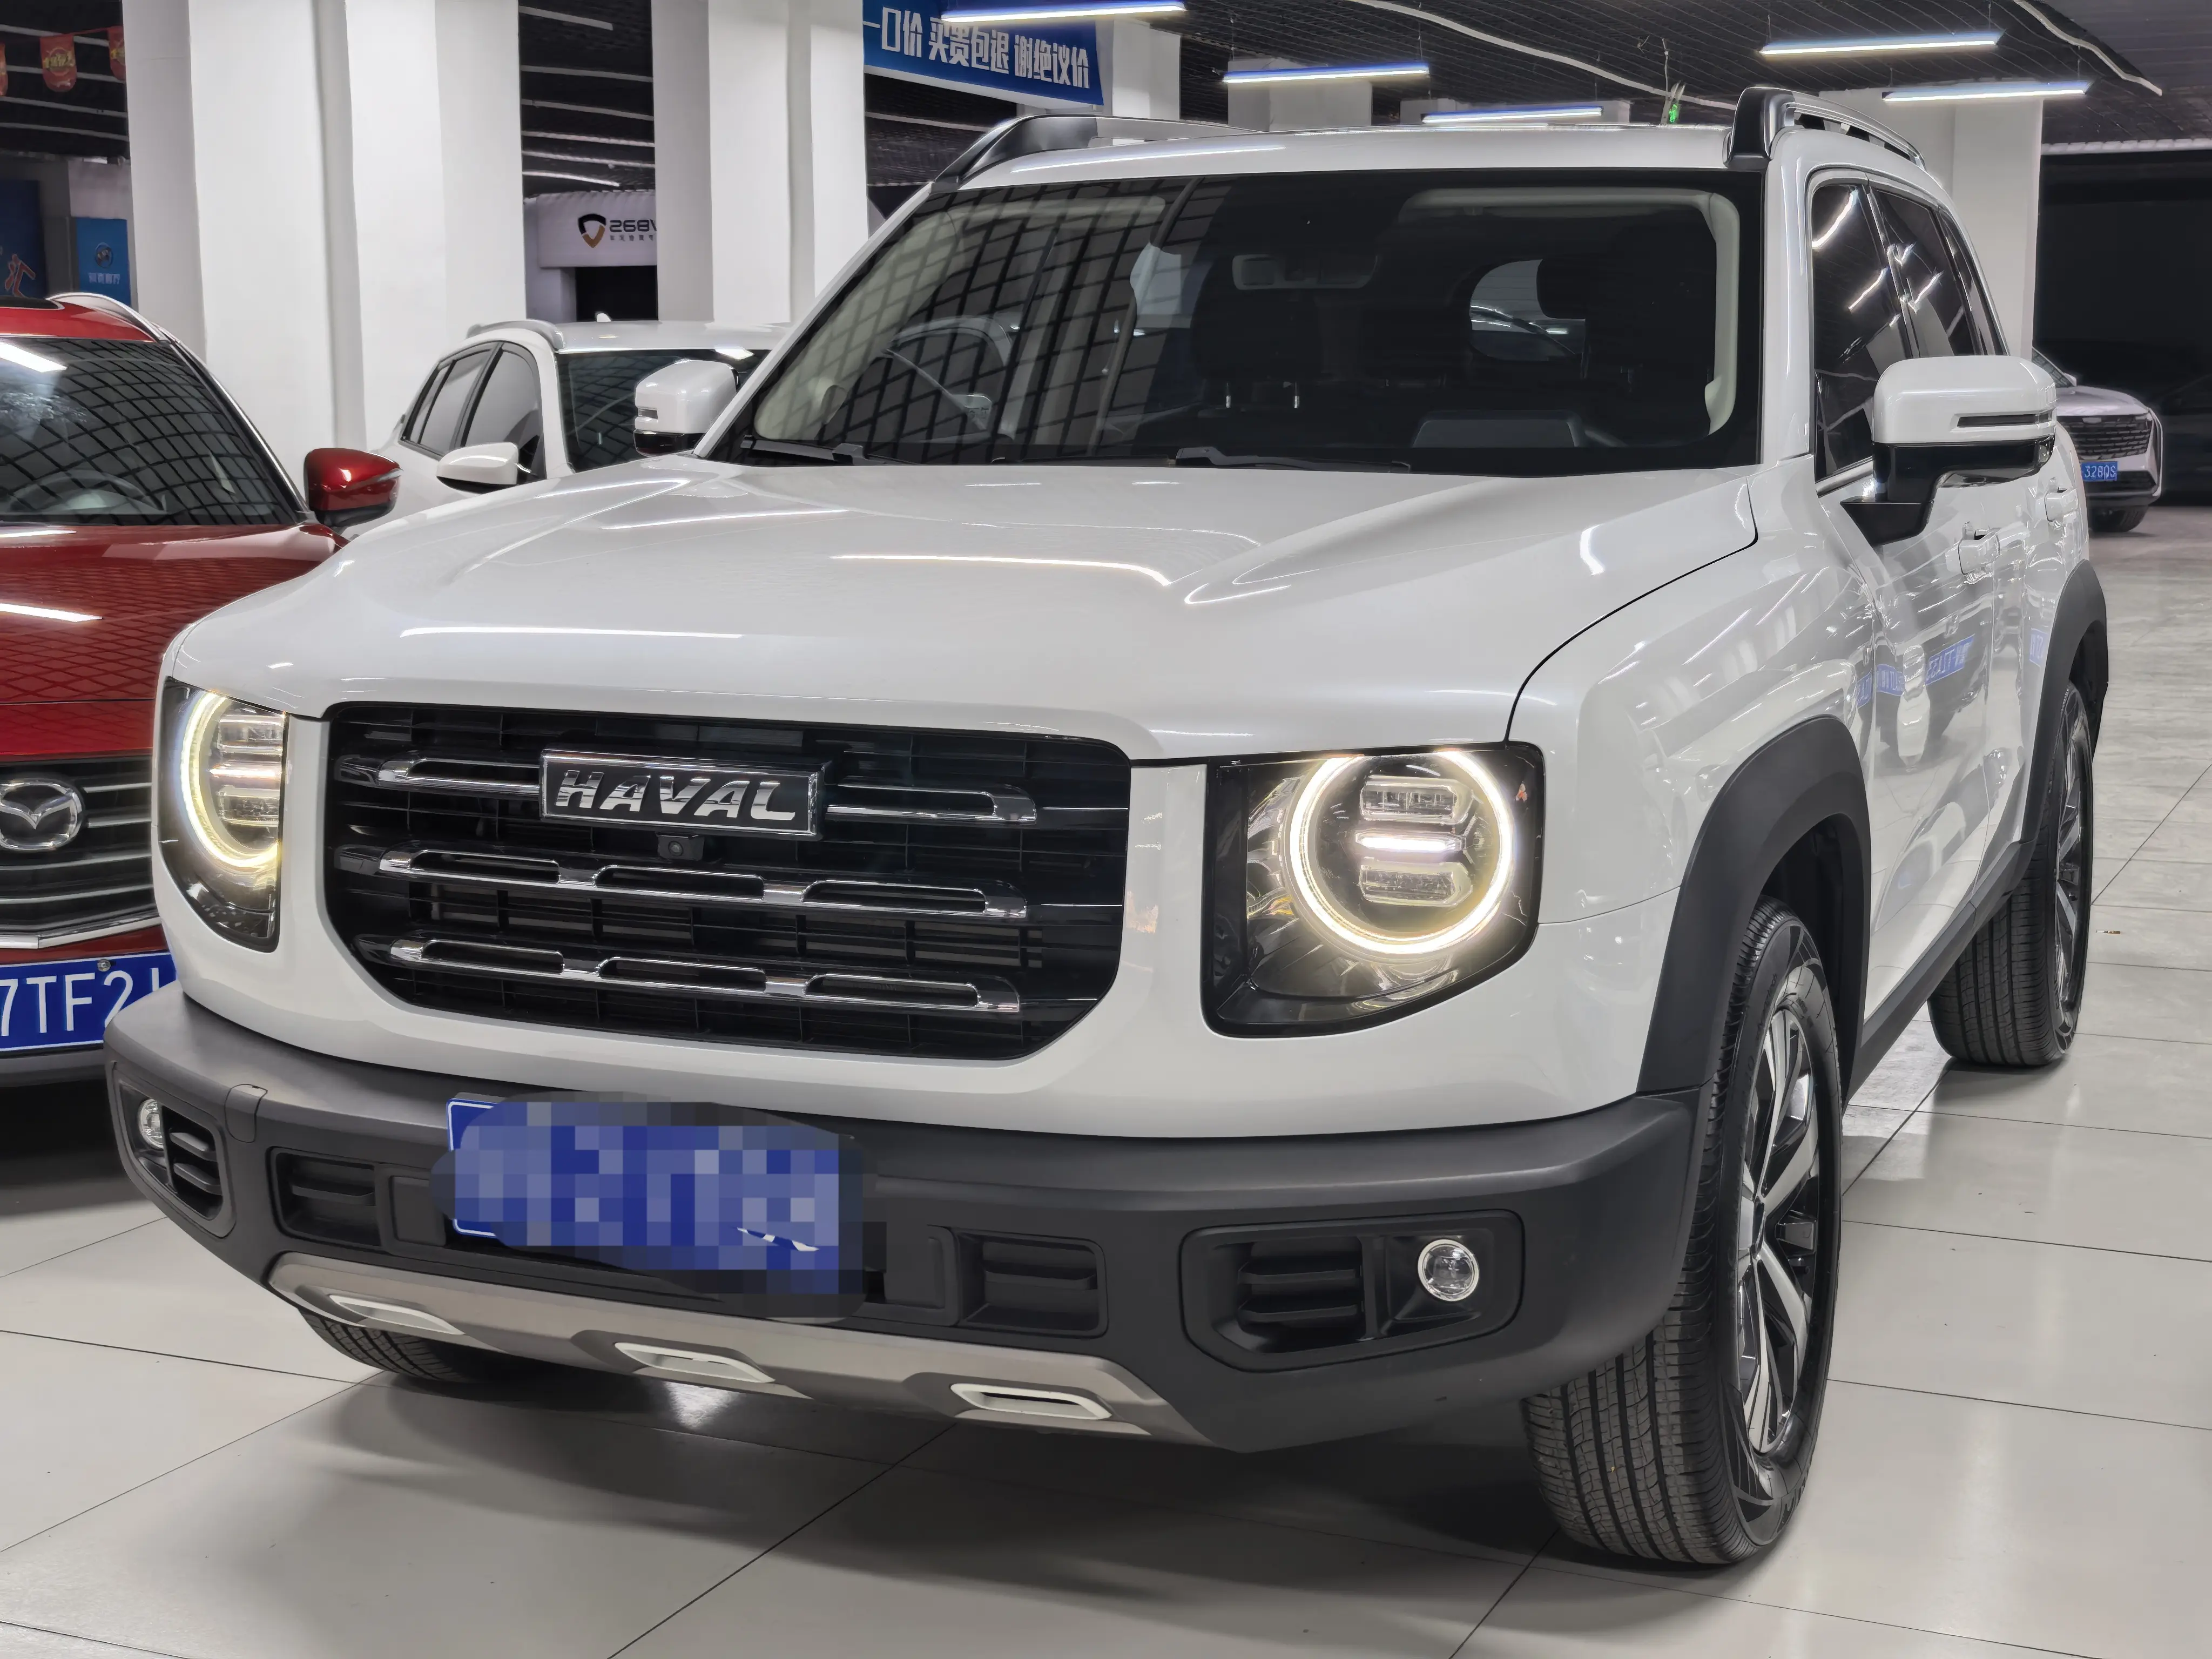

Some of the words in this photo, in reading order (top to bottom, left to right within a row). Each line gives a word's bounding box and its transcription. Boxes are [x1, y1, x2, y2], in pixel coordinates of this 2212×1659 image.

[862, 6, 922, 58] 一口价
[929, 17, 1009, 74] 买贵包退
[1014, 35, 1089, 89] 谢绝议价
[555, 770, 795, 821] HAVAL
